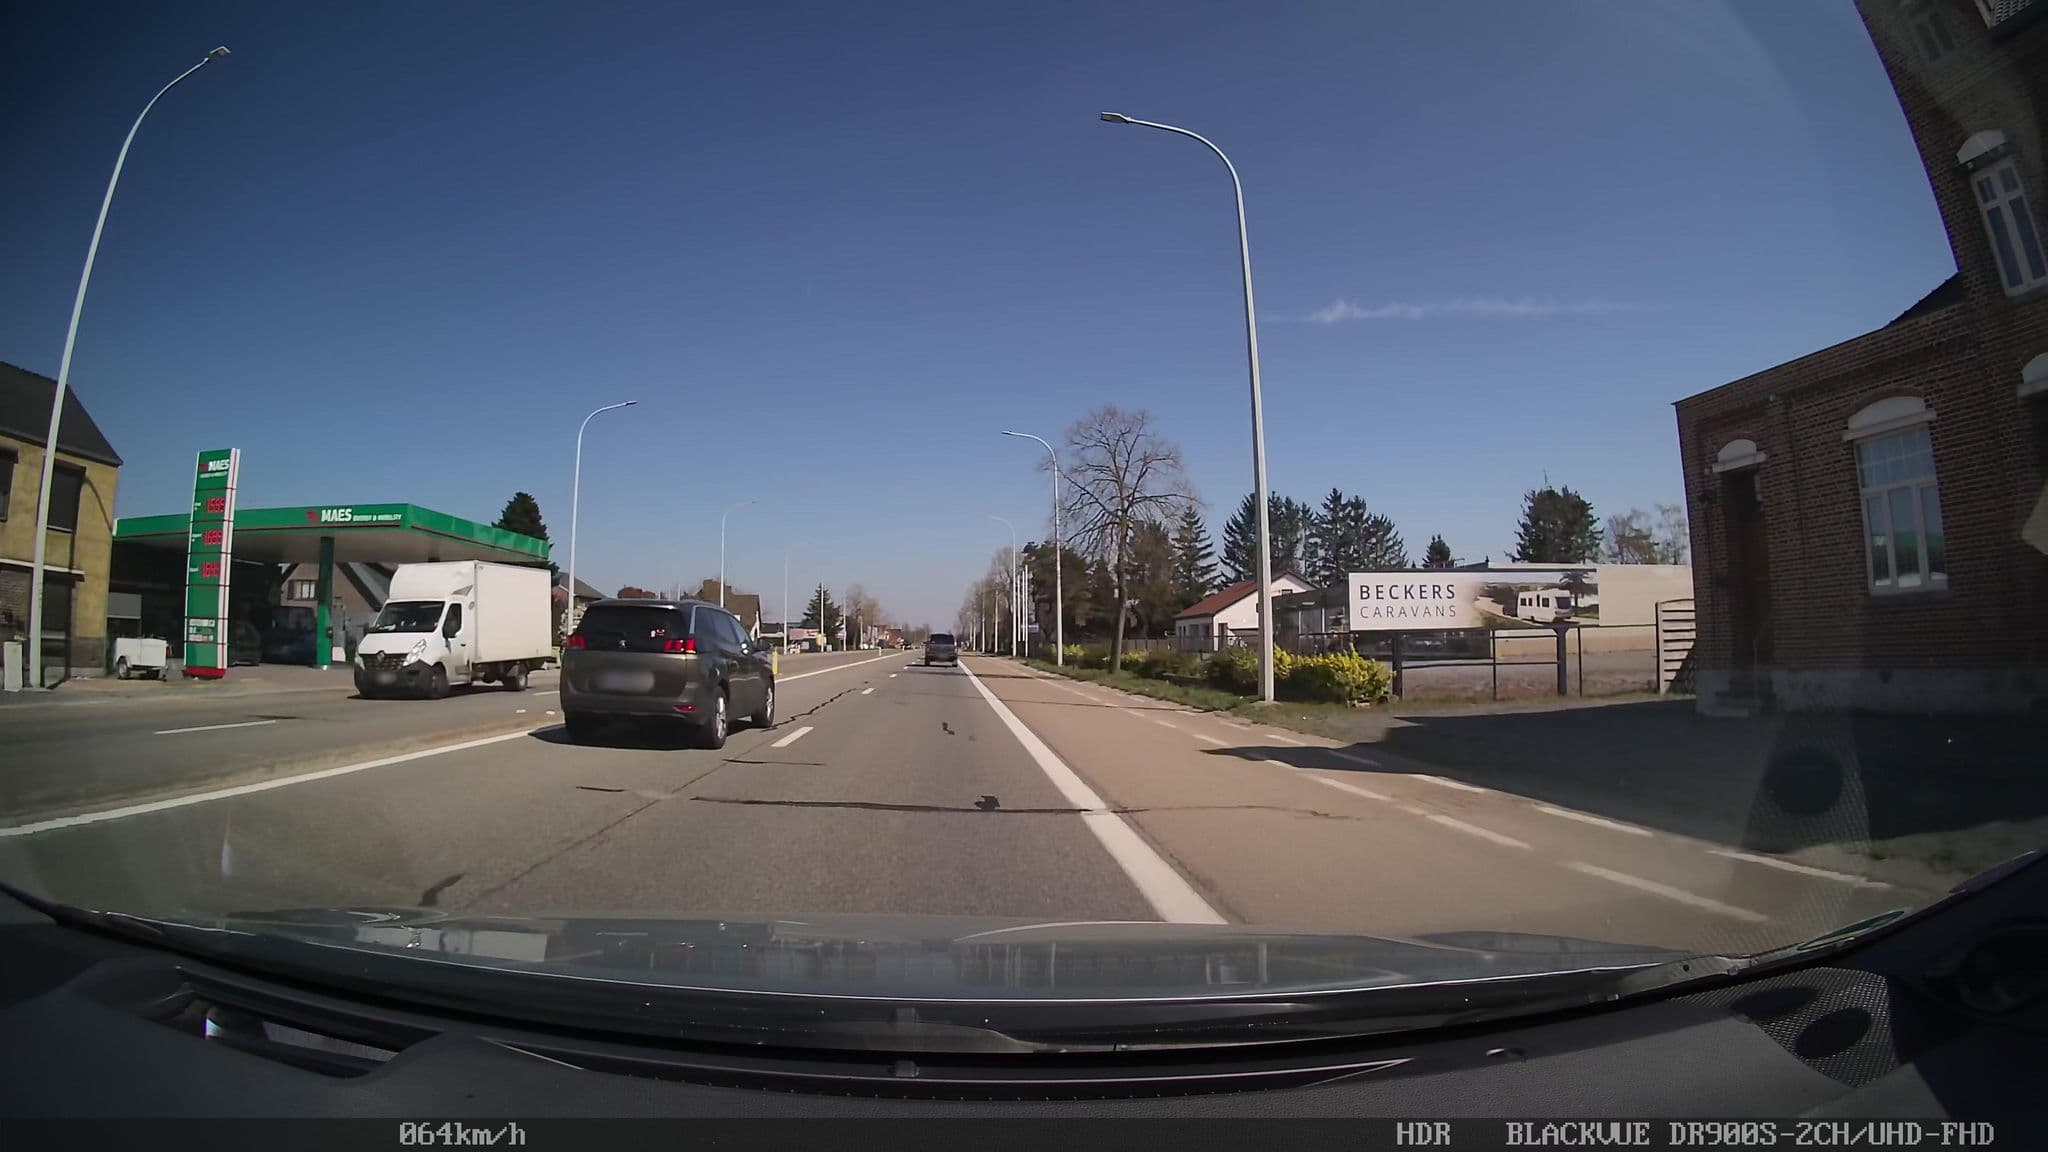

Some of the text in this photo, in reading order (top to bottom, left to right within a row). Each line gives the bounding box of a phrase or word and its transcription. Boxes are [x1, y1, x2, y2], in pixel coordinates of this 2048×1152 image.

[208, 459, 230, 471] MAES
[321, 509, 352, 522] MAES
[1360, 584, 1456, 600] BECKERS
[1360, 605, 1457, 619] CARAVANS
